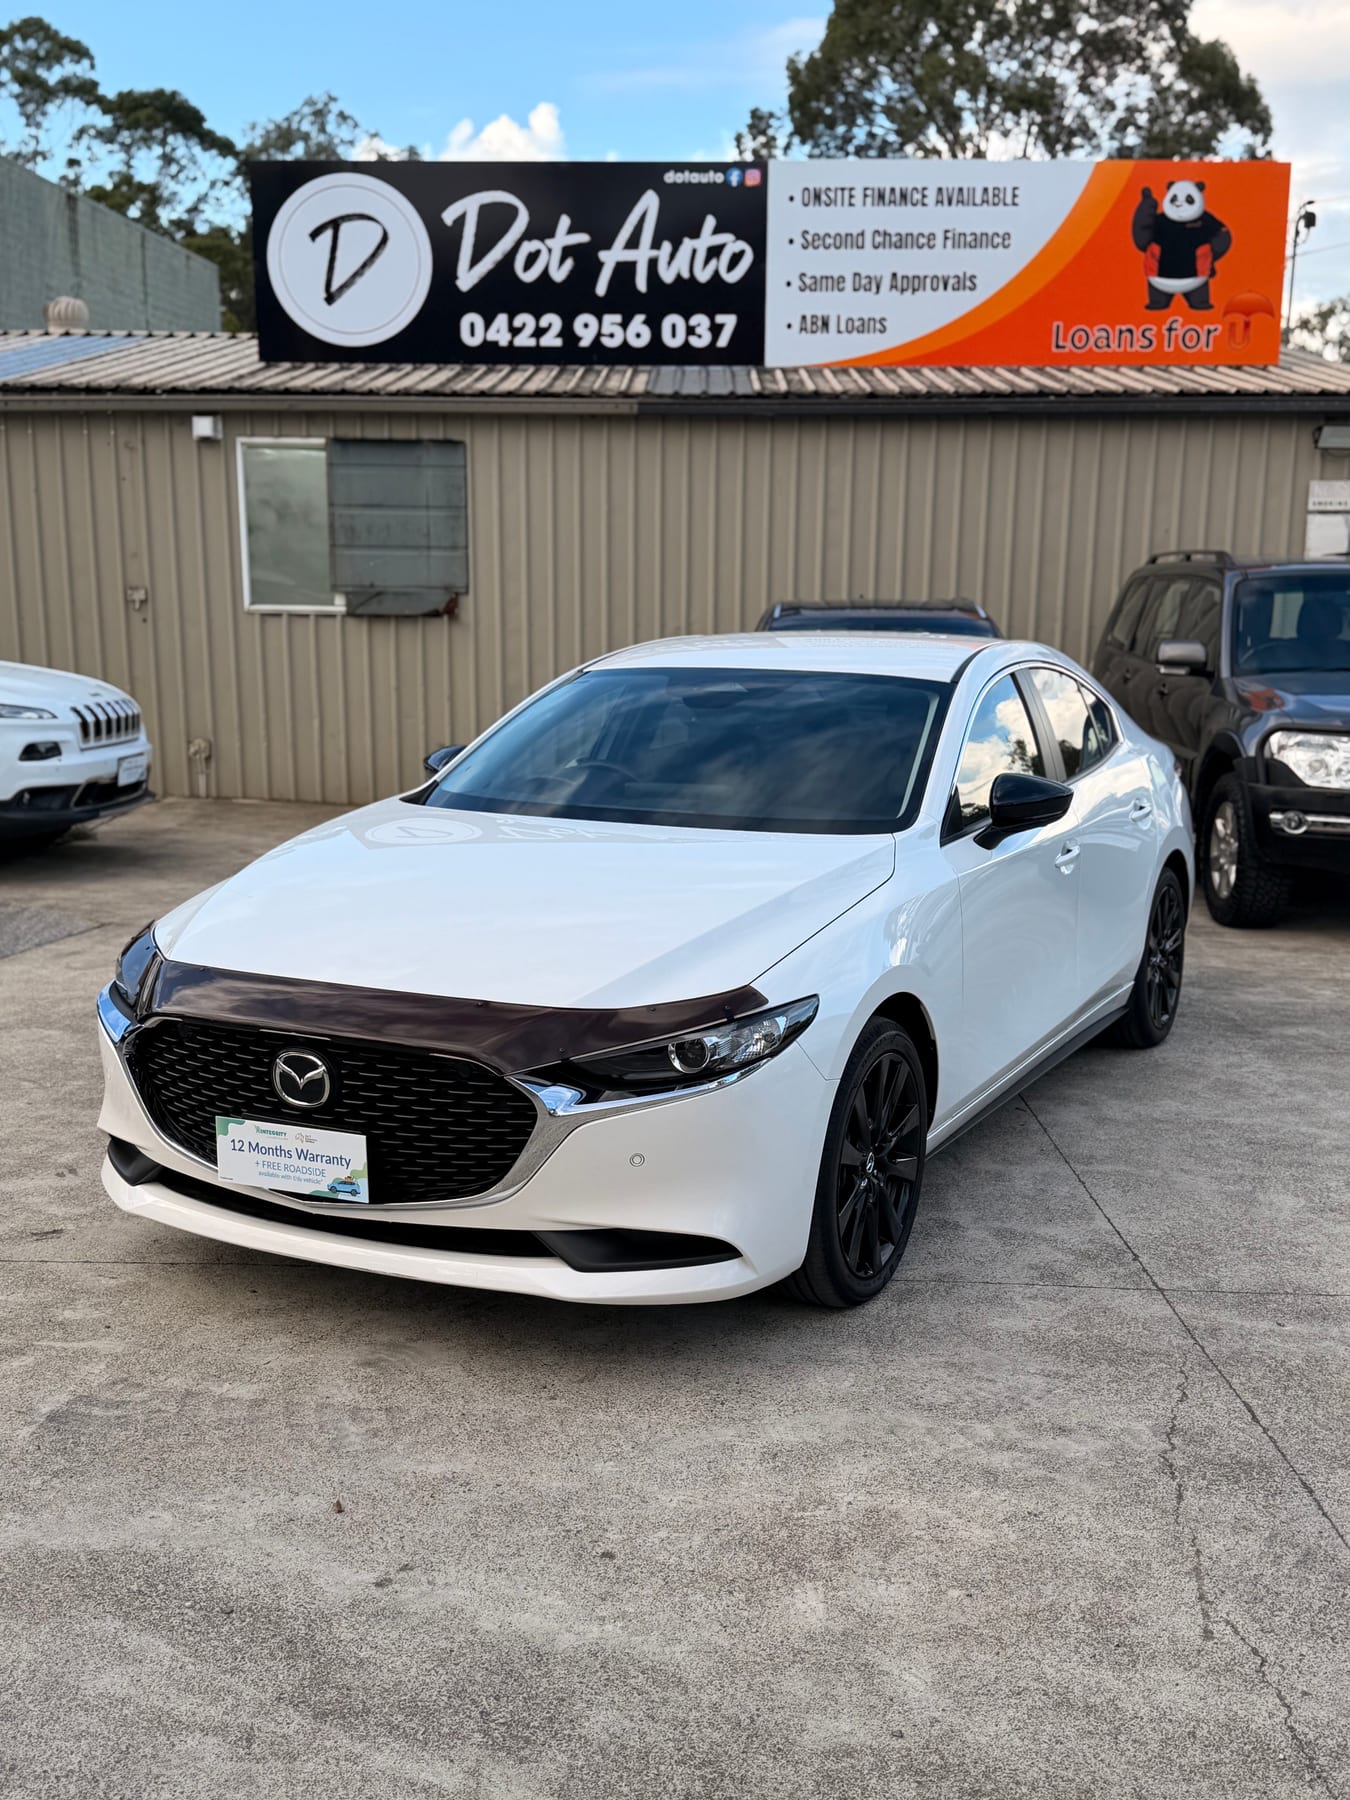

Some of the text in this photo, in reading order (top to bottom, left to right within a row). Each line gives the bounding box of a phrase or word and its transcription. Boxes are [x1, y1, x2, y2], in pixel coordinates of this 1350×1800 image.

[663, 170, 725, 184] dotauto
[801, 186, 1019, 207] ONSITE FINANCE AVAILABLE
[440, 189, 754, 297] Dot Auto
[801, 229, 1011, 250] Second Chance Finance
[308, 212, 389, 307] D
[798, 271, 977, 295] Same Day Approvals
[459, 312, 738, 348] 0422 956 037
[799, 314, 888, 335] ABN Loans
[1053, 320, 1156, 353] Loans
[1163, 316, 1221, 353] for
[230, 1138, 352, 1170] 12 Months Warranty
[262, 1160, 282, 1171] FREE
[283, 1163, 327, 1178] ROADSIDE
